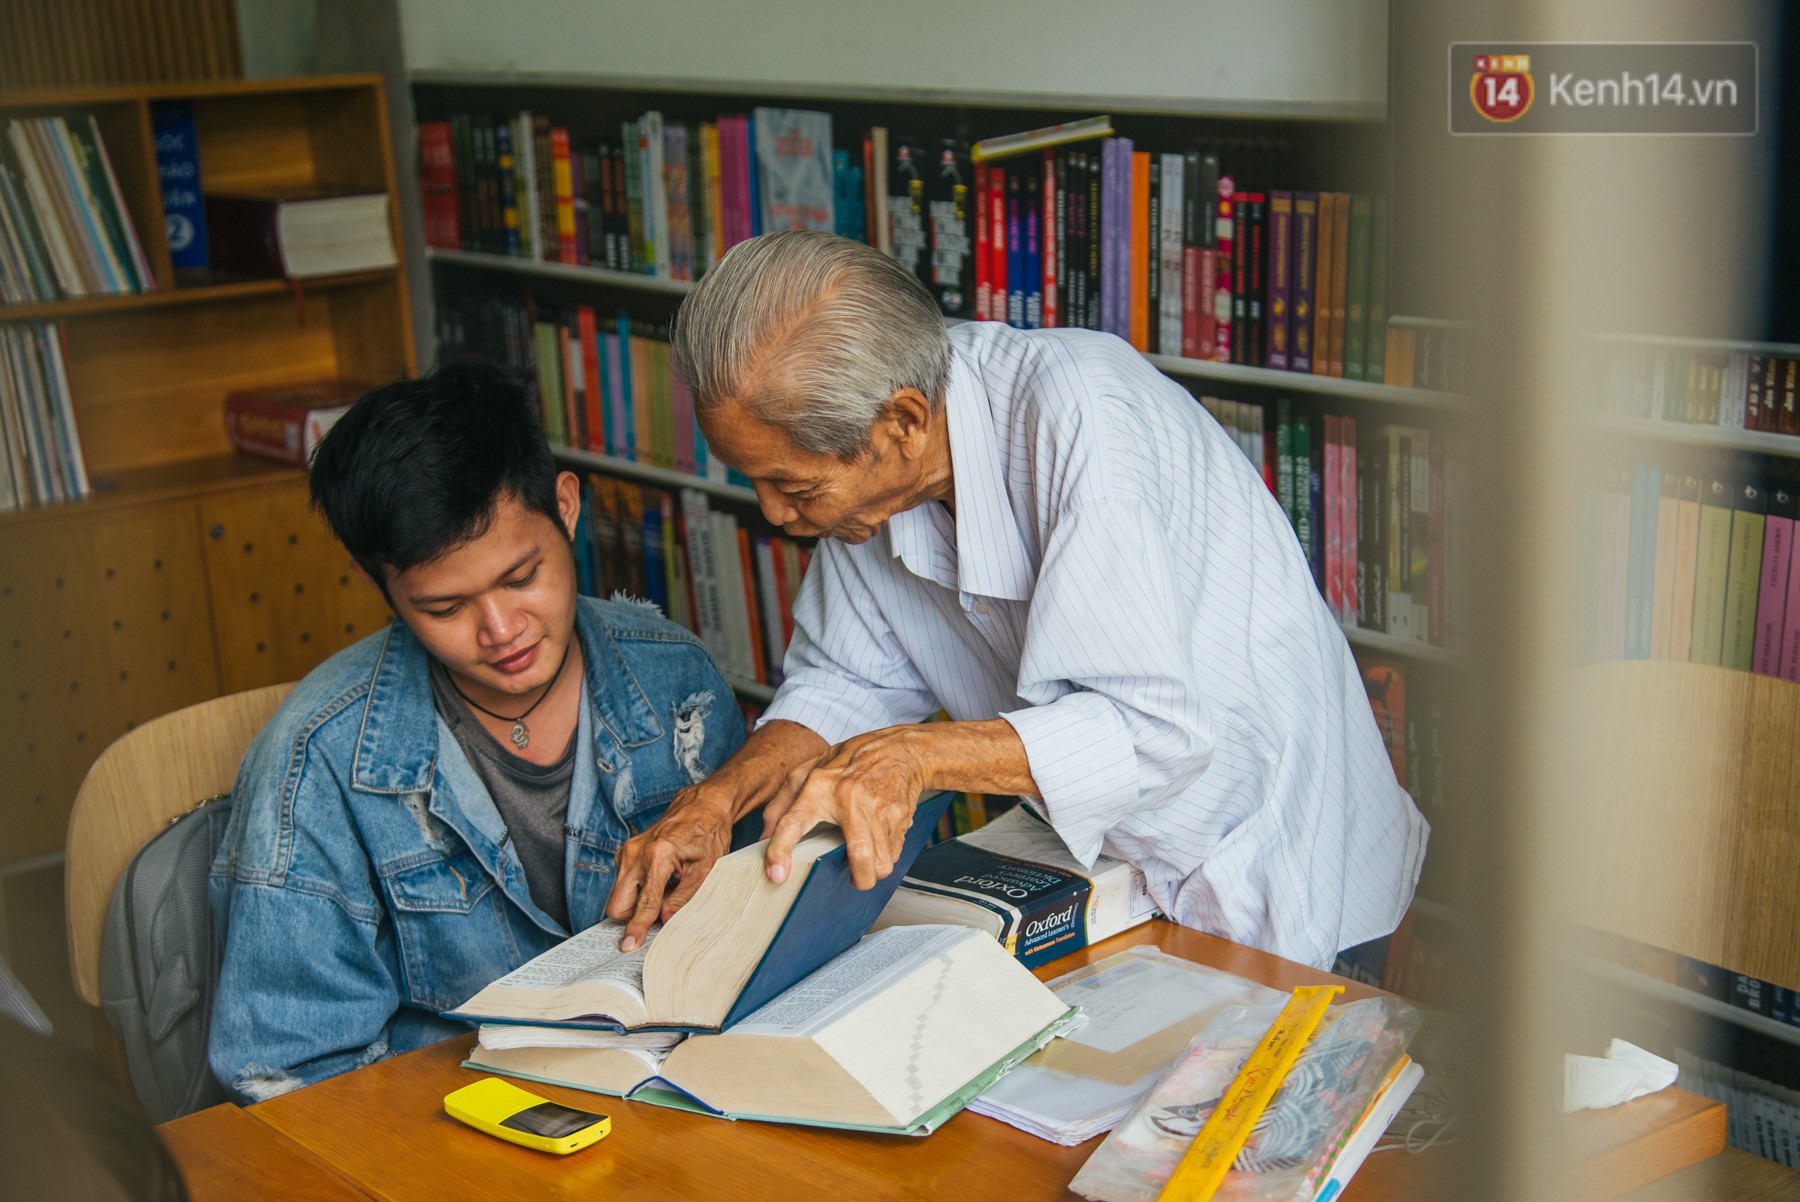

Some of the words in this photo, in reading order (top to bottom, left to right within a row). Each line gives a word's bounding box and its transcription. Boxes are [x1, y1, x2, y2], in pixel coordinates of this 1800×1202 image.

[953, 875, 1029, 899] Oxford
[980, 872, 1042, 892] Advanced
[1025, 905, 1073, 938] Oxford
[1024, 930, 1049, 947] Advanced
[1047, 923, 1070, 938] Learner's
[1024, 947, 1034, 957] with
[1033, 939, 1056, 953] Vietnamese
[1055, 931, 1076, 943] Translation
